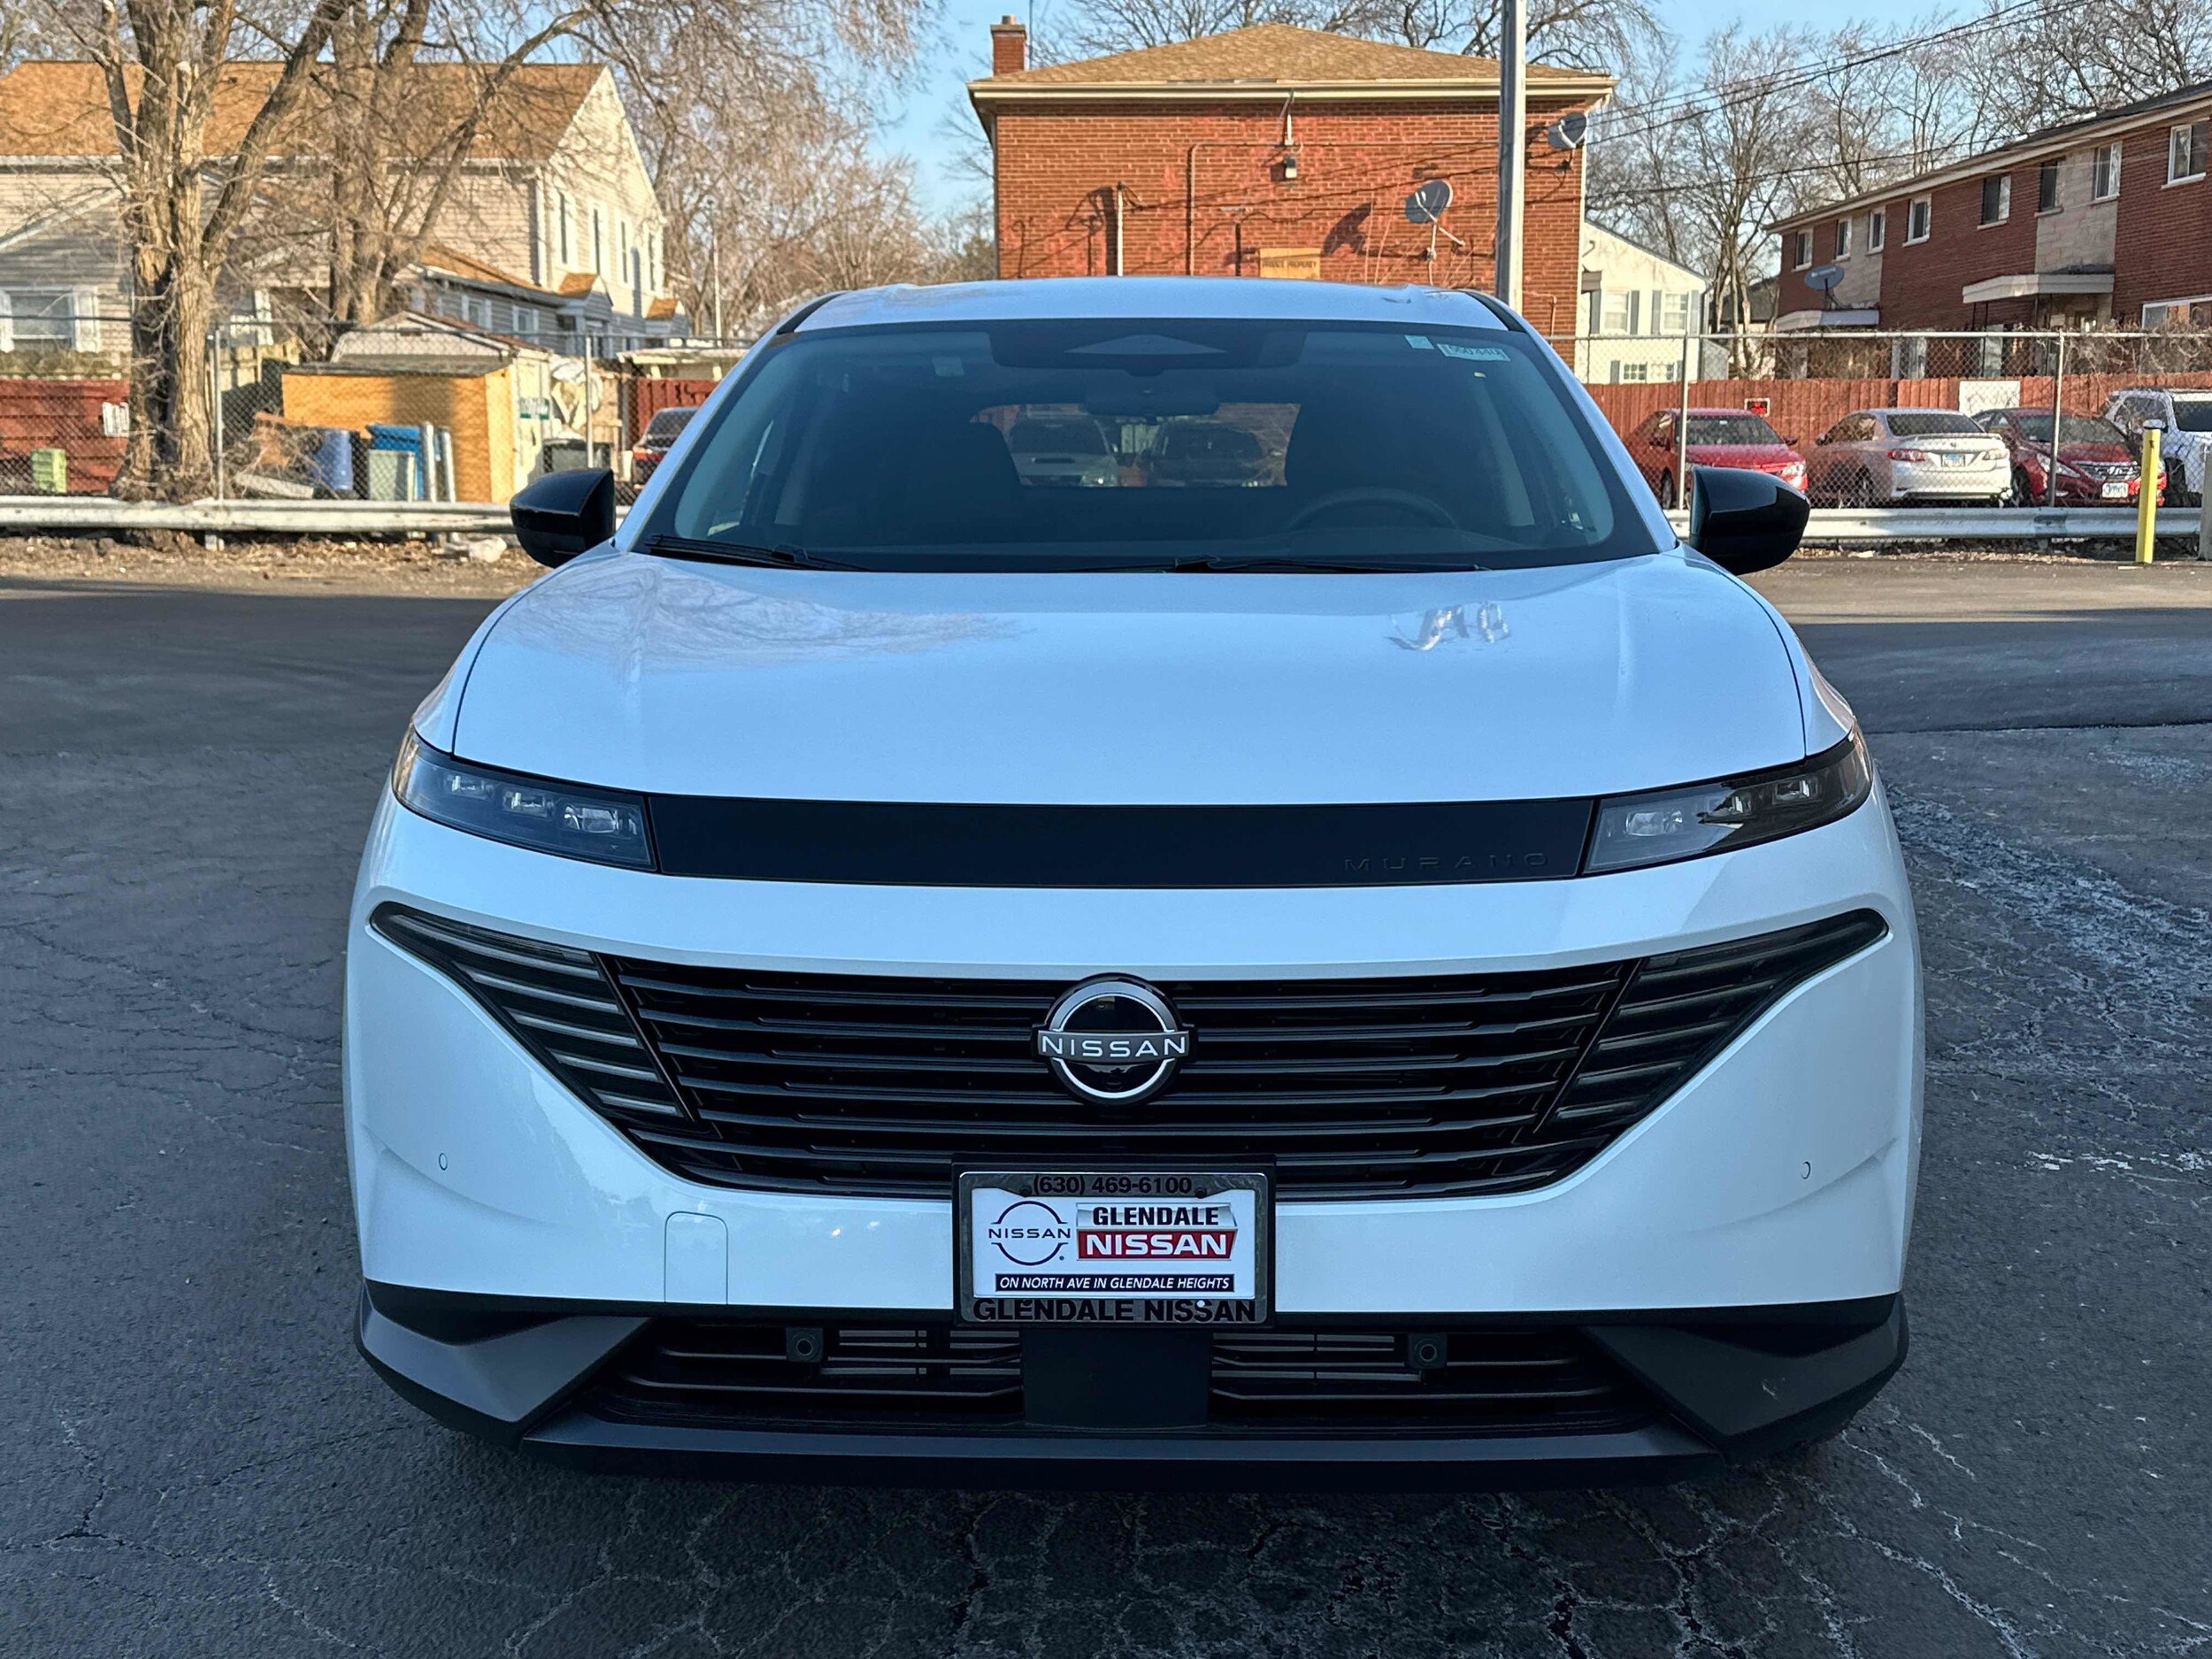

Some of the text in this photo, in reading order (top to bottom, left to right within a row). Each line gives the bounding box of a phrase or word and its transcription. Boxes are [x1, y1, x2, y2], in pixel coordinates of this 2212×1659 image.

[1344, 852, 1547, 872] MURANO
[1041, 1036, 1186, 1057] NISSAN
[1033, 1175, 1192, 1194] (630) 469-6100
[1093, 1206, 1218, 1225] GLENDALE
[988, 1228, 1071, 1239] NISSAN
[1087, 1234, 1226, 1256] NISSAN
[1000, 1277, 1230, 1289] ON NORTH AVE IN GLENDALE HEIGHTS
[973, 1298, 1256, 1322] GLENDALE NISSAN
